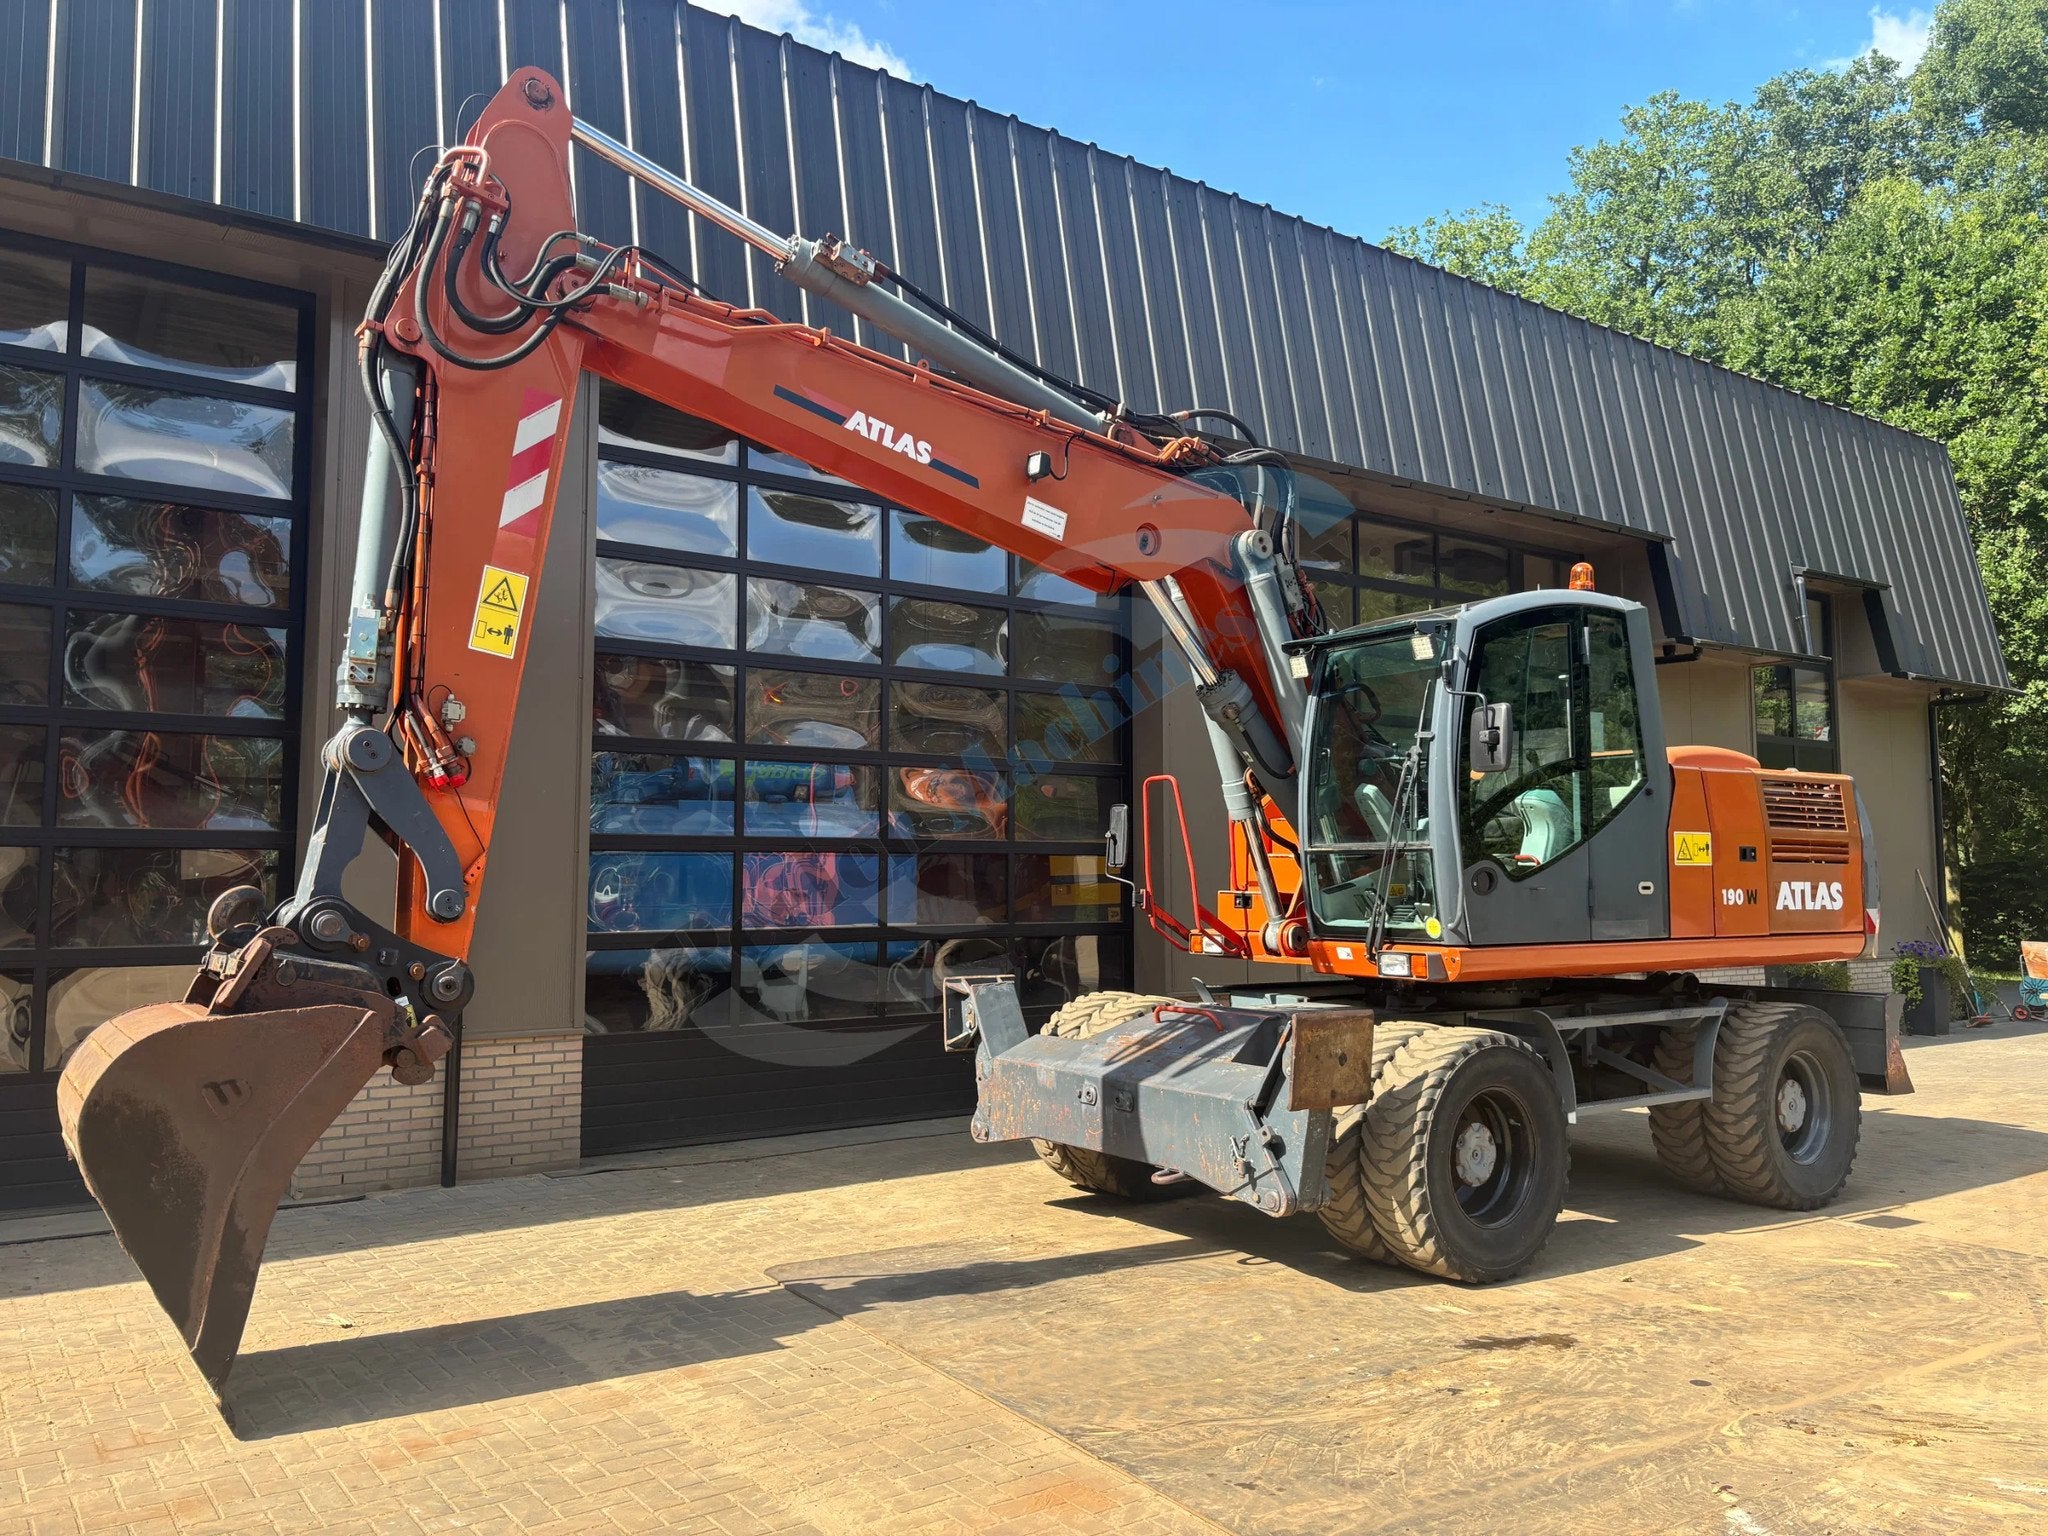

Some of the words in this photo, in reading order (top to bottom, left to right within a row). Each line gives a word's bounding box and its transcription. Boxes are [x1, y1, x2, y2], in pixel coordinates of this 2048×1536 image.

[843, 410, 932, 465] ATLAS
[1721, 888, 1744, 906] 190
[1746, 889, 1758, 905] W
[1775, 881, 1844, 911] ATLAS
